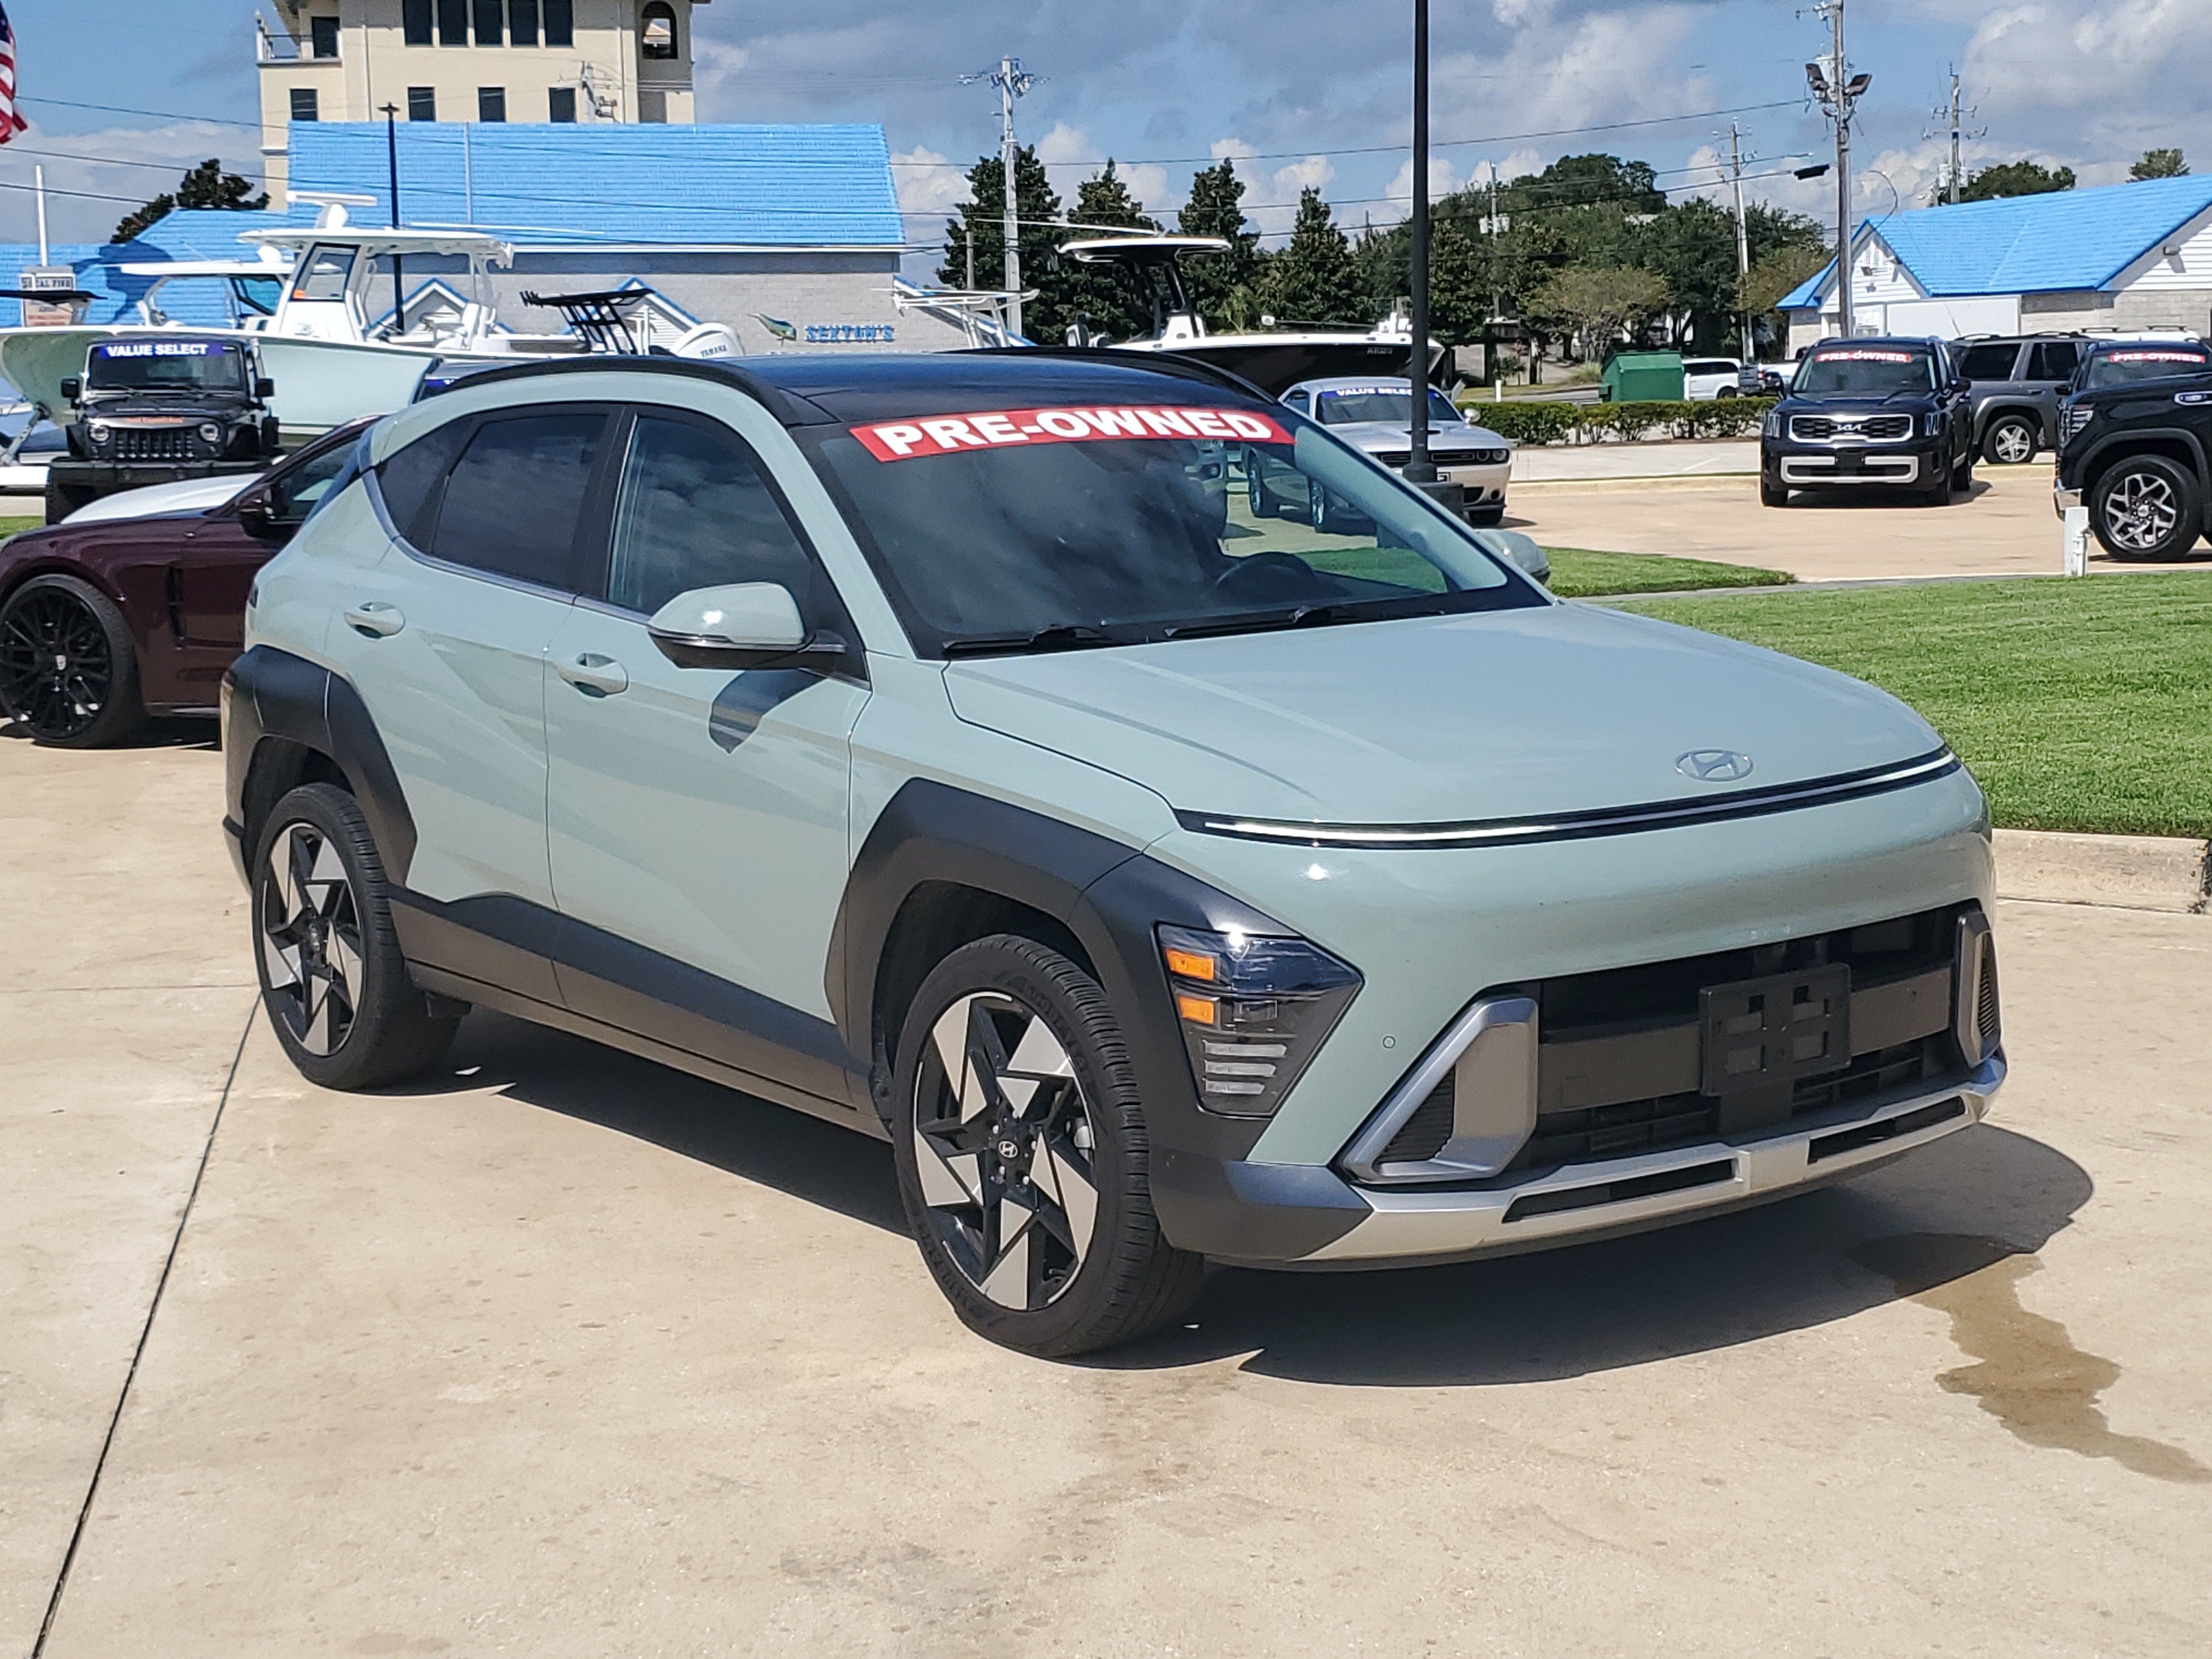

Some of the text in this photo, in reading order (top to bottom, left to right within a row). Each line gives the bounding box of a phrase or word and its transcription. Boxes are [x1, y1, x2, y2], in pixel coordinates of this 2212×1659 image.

[806, 324, 894, 342] SEXTON'S
[105, 343, 208, 357] VALUE SELECT
[700, 345, 727, 358] YAMAHA
[1819, 352, 1908, 362] PRE-OWNED
[2113, 353, 2202, 362] PRE-OWNED
[1336, 388, 1413, 396] VALUE SELEC
[872, 410, 1274, 455] PRE-OWNED
